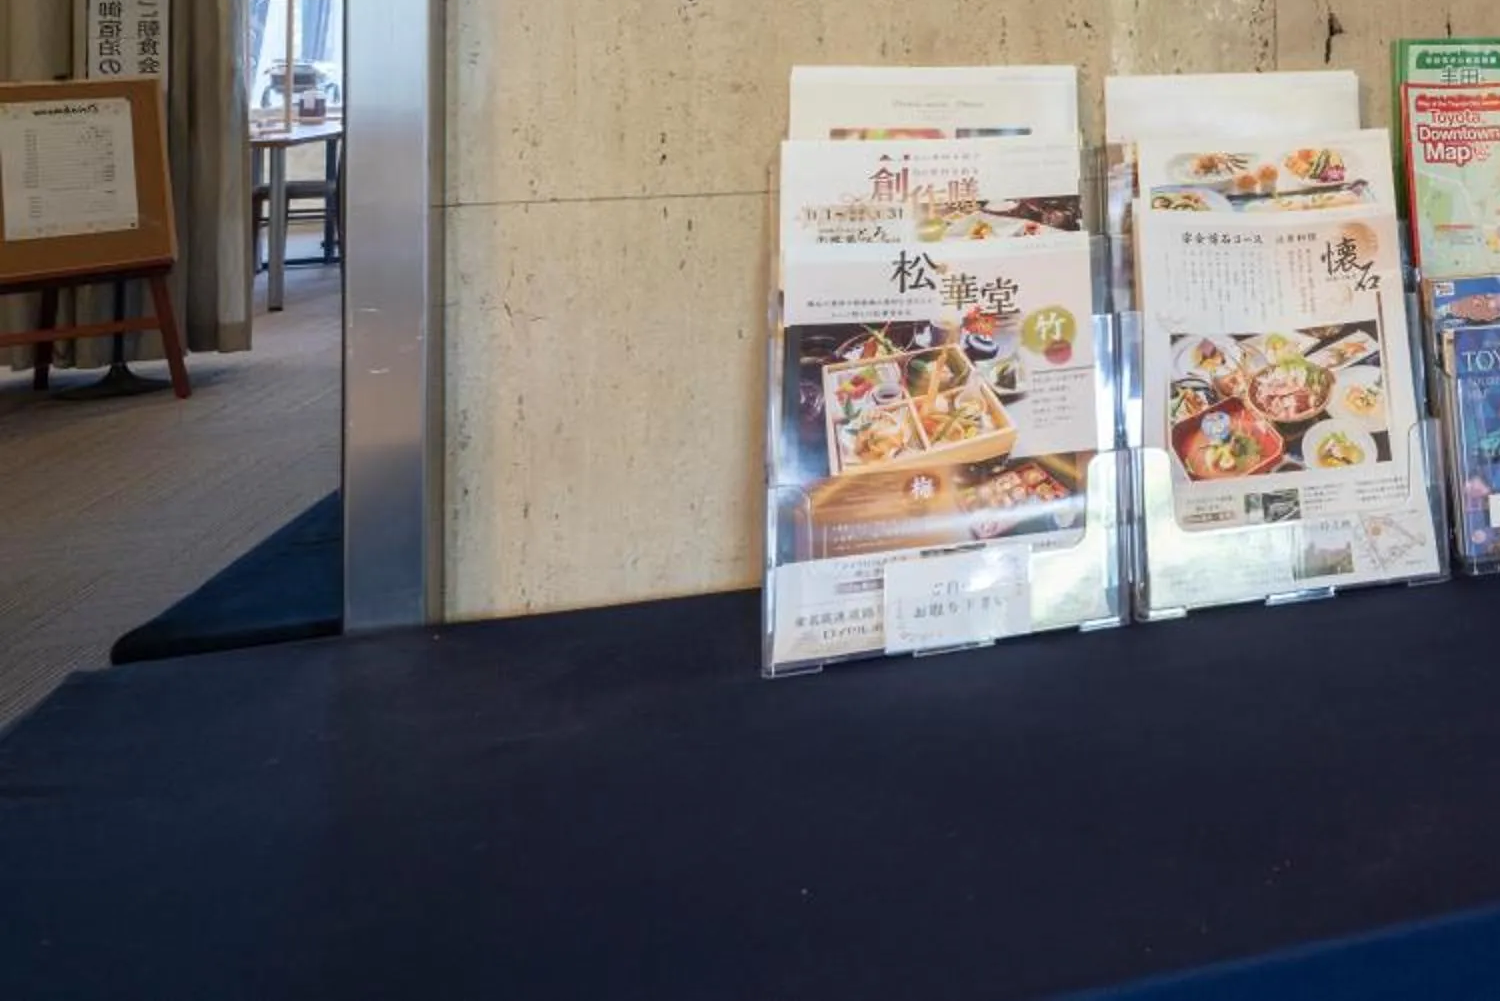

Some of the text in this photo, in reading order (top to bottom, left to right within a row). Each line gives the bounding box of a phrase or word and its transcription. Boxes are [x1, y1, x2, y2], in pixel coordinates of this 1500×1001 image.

[1430, 109, 1481, 126] Toyota
[1419, 126, 1500, 141] Downtown
[1425, 142, 1471, 164] Map
[1036, 312, 1067, 341] 竹
